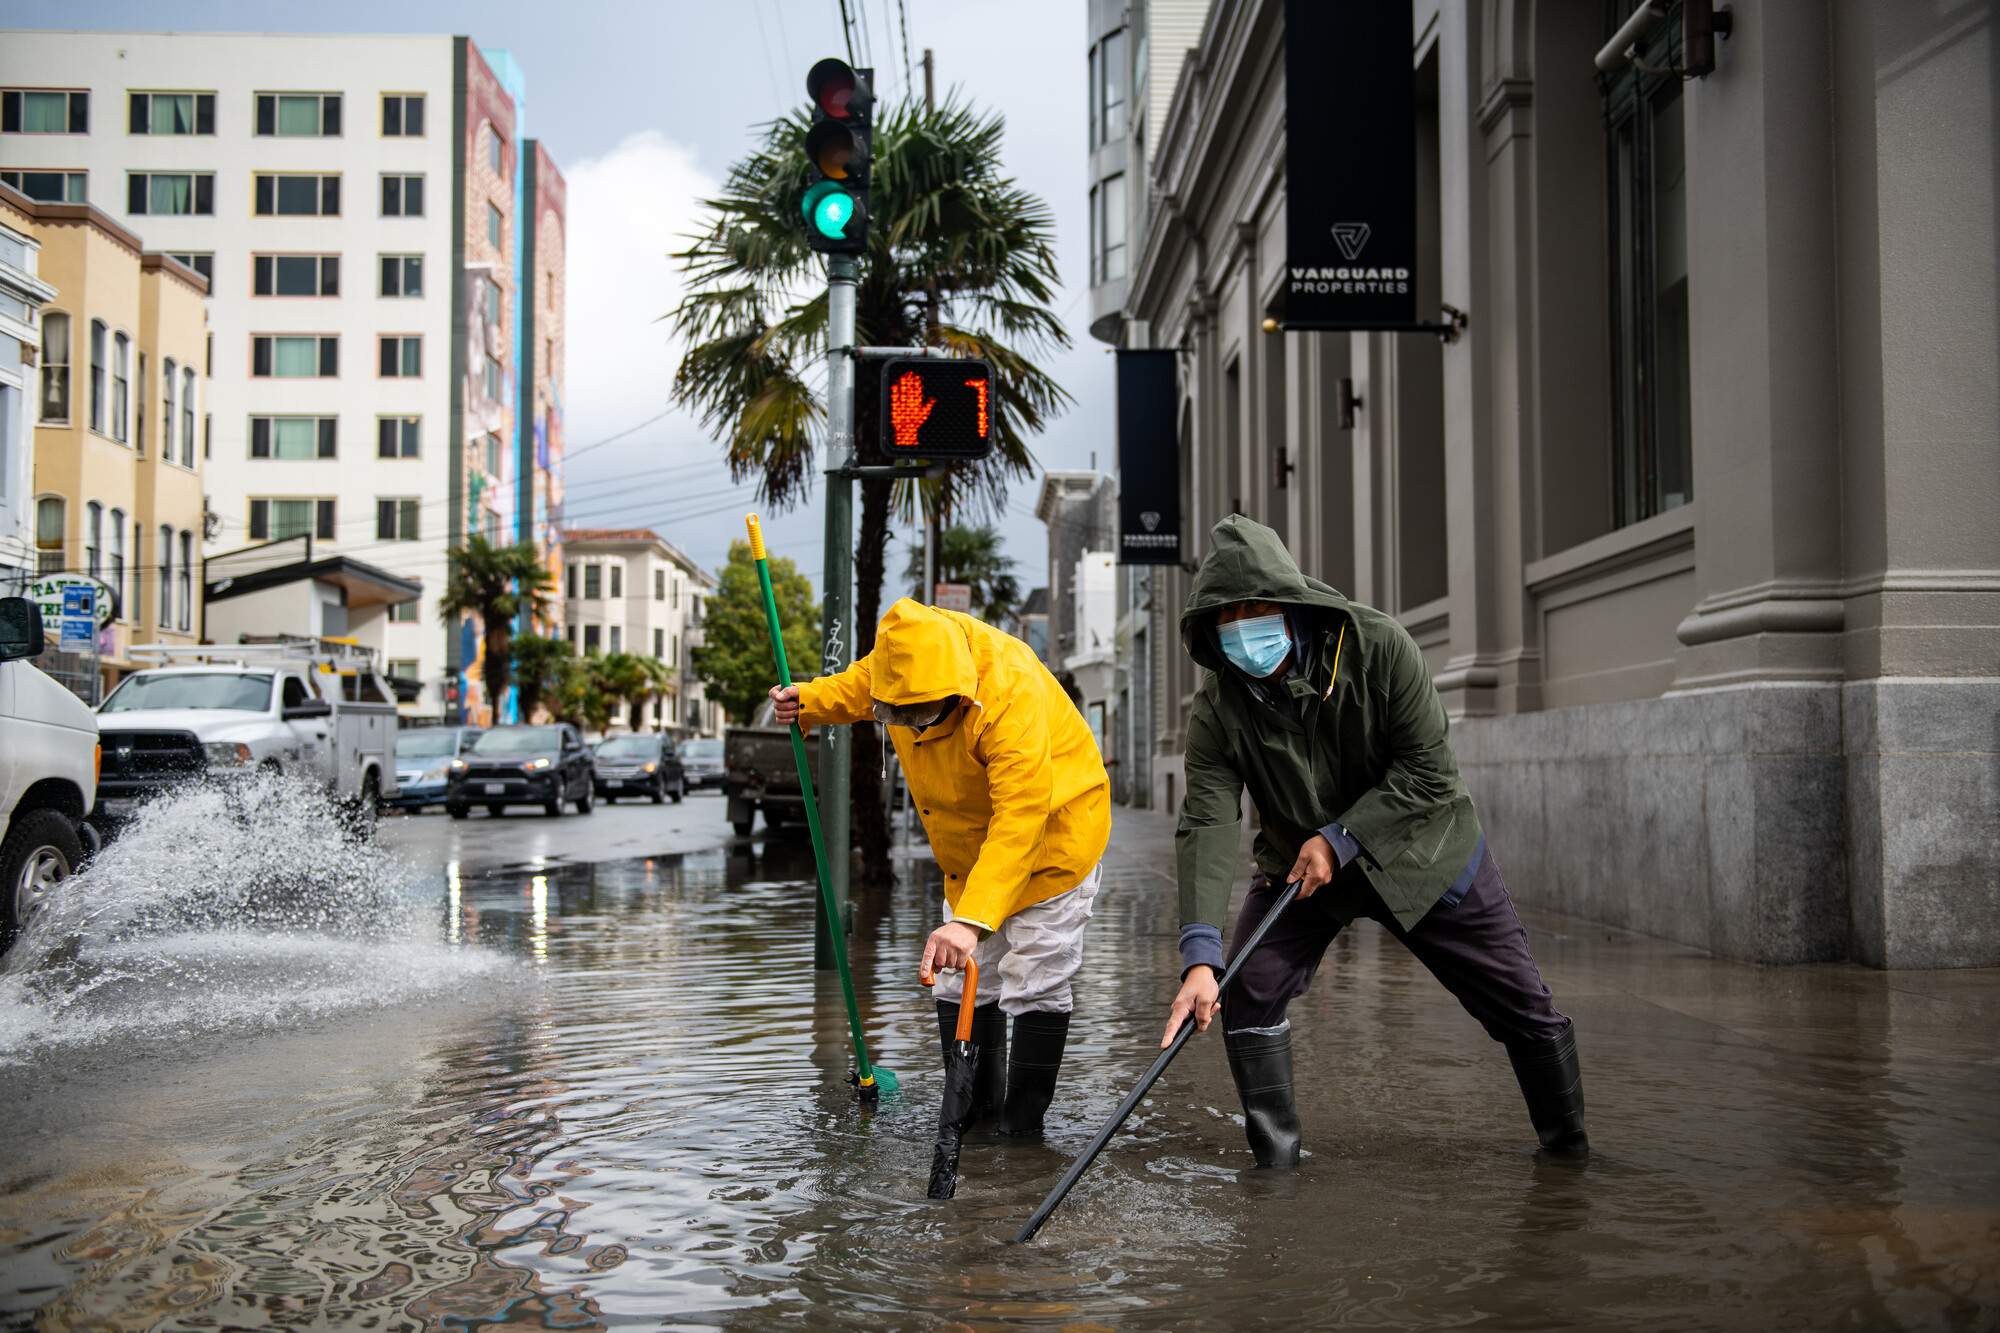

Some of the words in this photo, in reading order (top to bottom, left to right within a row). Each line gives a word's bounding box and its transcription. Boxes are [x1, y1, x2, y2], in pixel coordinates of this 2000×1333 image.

[1291, 267, 1409, 280] VANGUARD
[1291, 281, 1408, 294] PROPERTIES
[964, 379, 989, 438] 7
